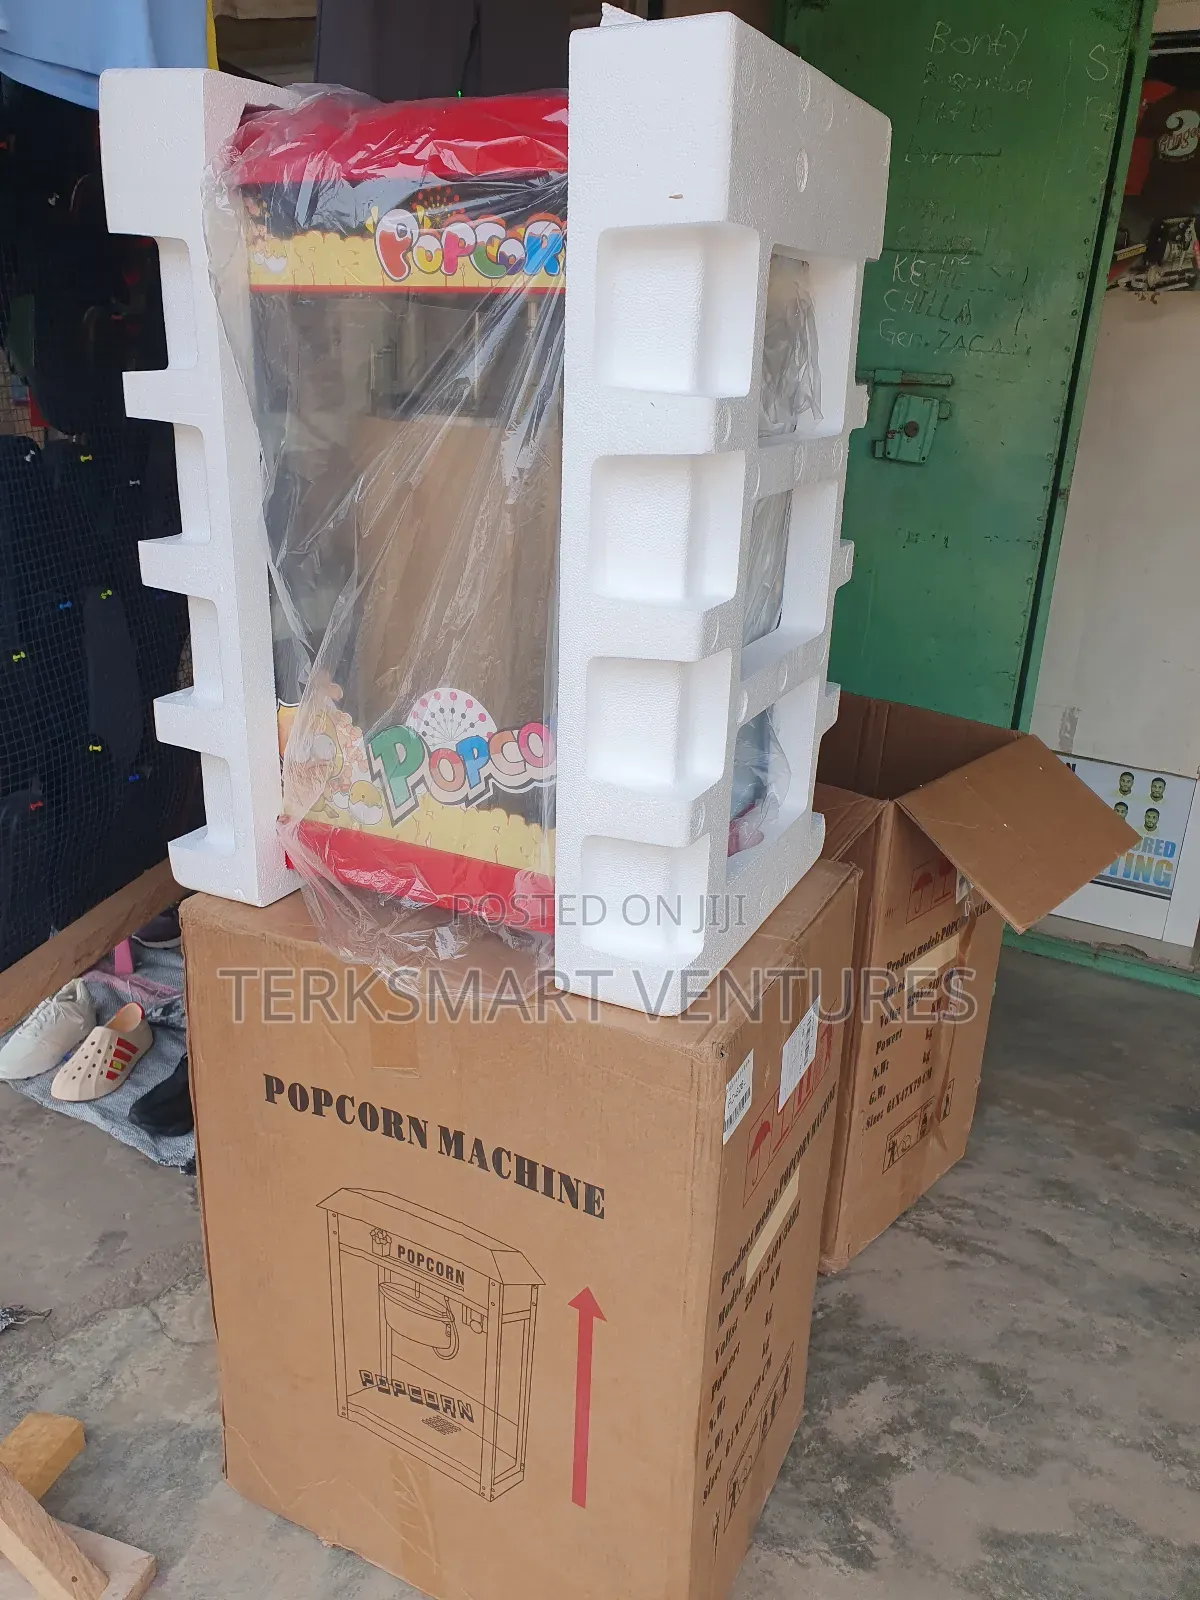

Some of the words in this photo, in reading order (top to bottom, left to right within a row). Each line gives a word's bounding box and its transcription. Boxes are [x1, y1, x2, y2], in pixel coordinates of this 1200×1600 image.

[366, 715, 557, 826] POPCO
[263, 1073, 429, 1150] POPCORN
[437, 1124, 605, 1220] MACHINE
[397, 1244, 465, 1286] POPCORN
[359, 1369, 474, 1423] POPCORN
